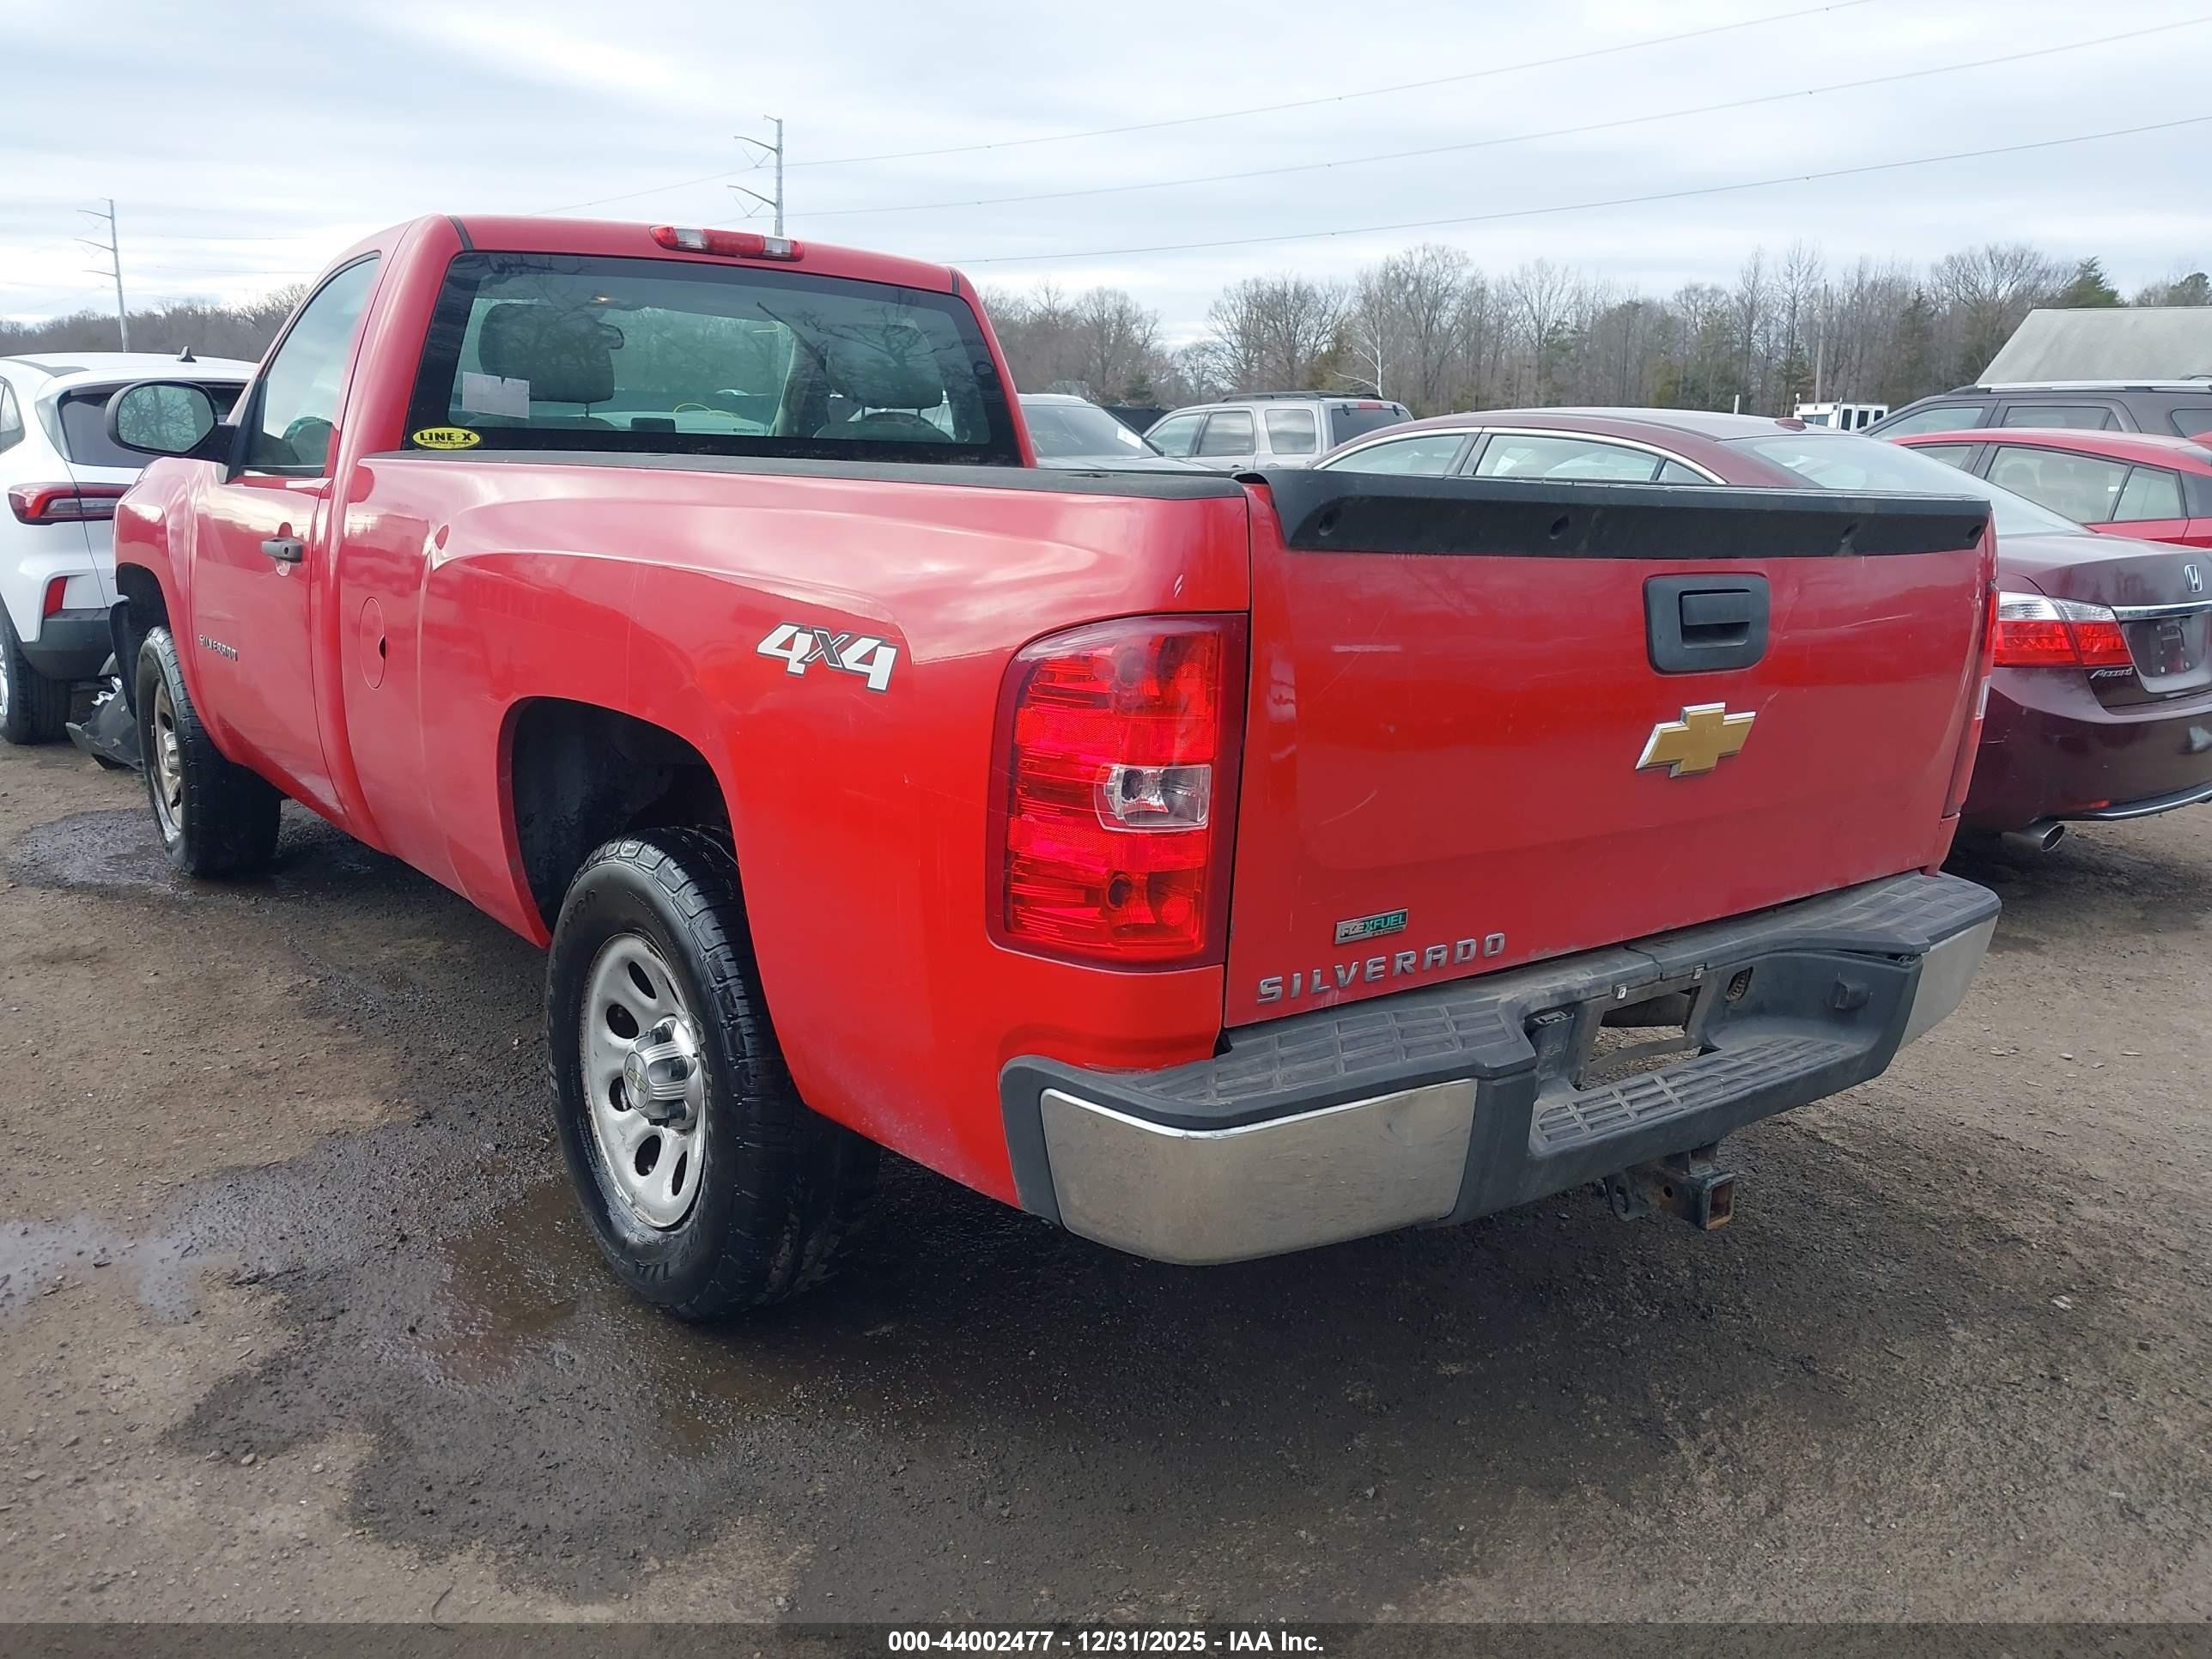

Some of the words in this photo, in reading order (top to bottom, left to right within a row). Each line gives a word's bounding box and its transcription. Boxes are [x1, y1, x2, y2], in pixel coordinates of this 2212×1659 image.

[419, 432, 473, 441] LINE-X
[198, 634, 238, 661] SILVERADO
[2089, 666, 2134, 679] Accord
[1256, 933, 1506, 1004] SILVERADO
